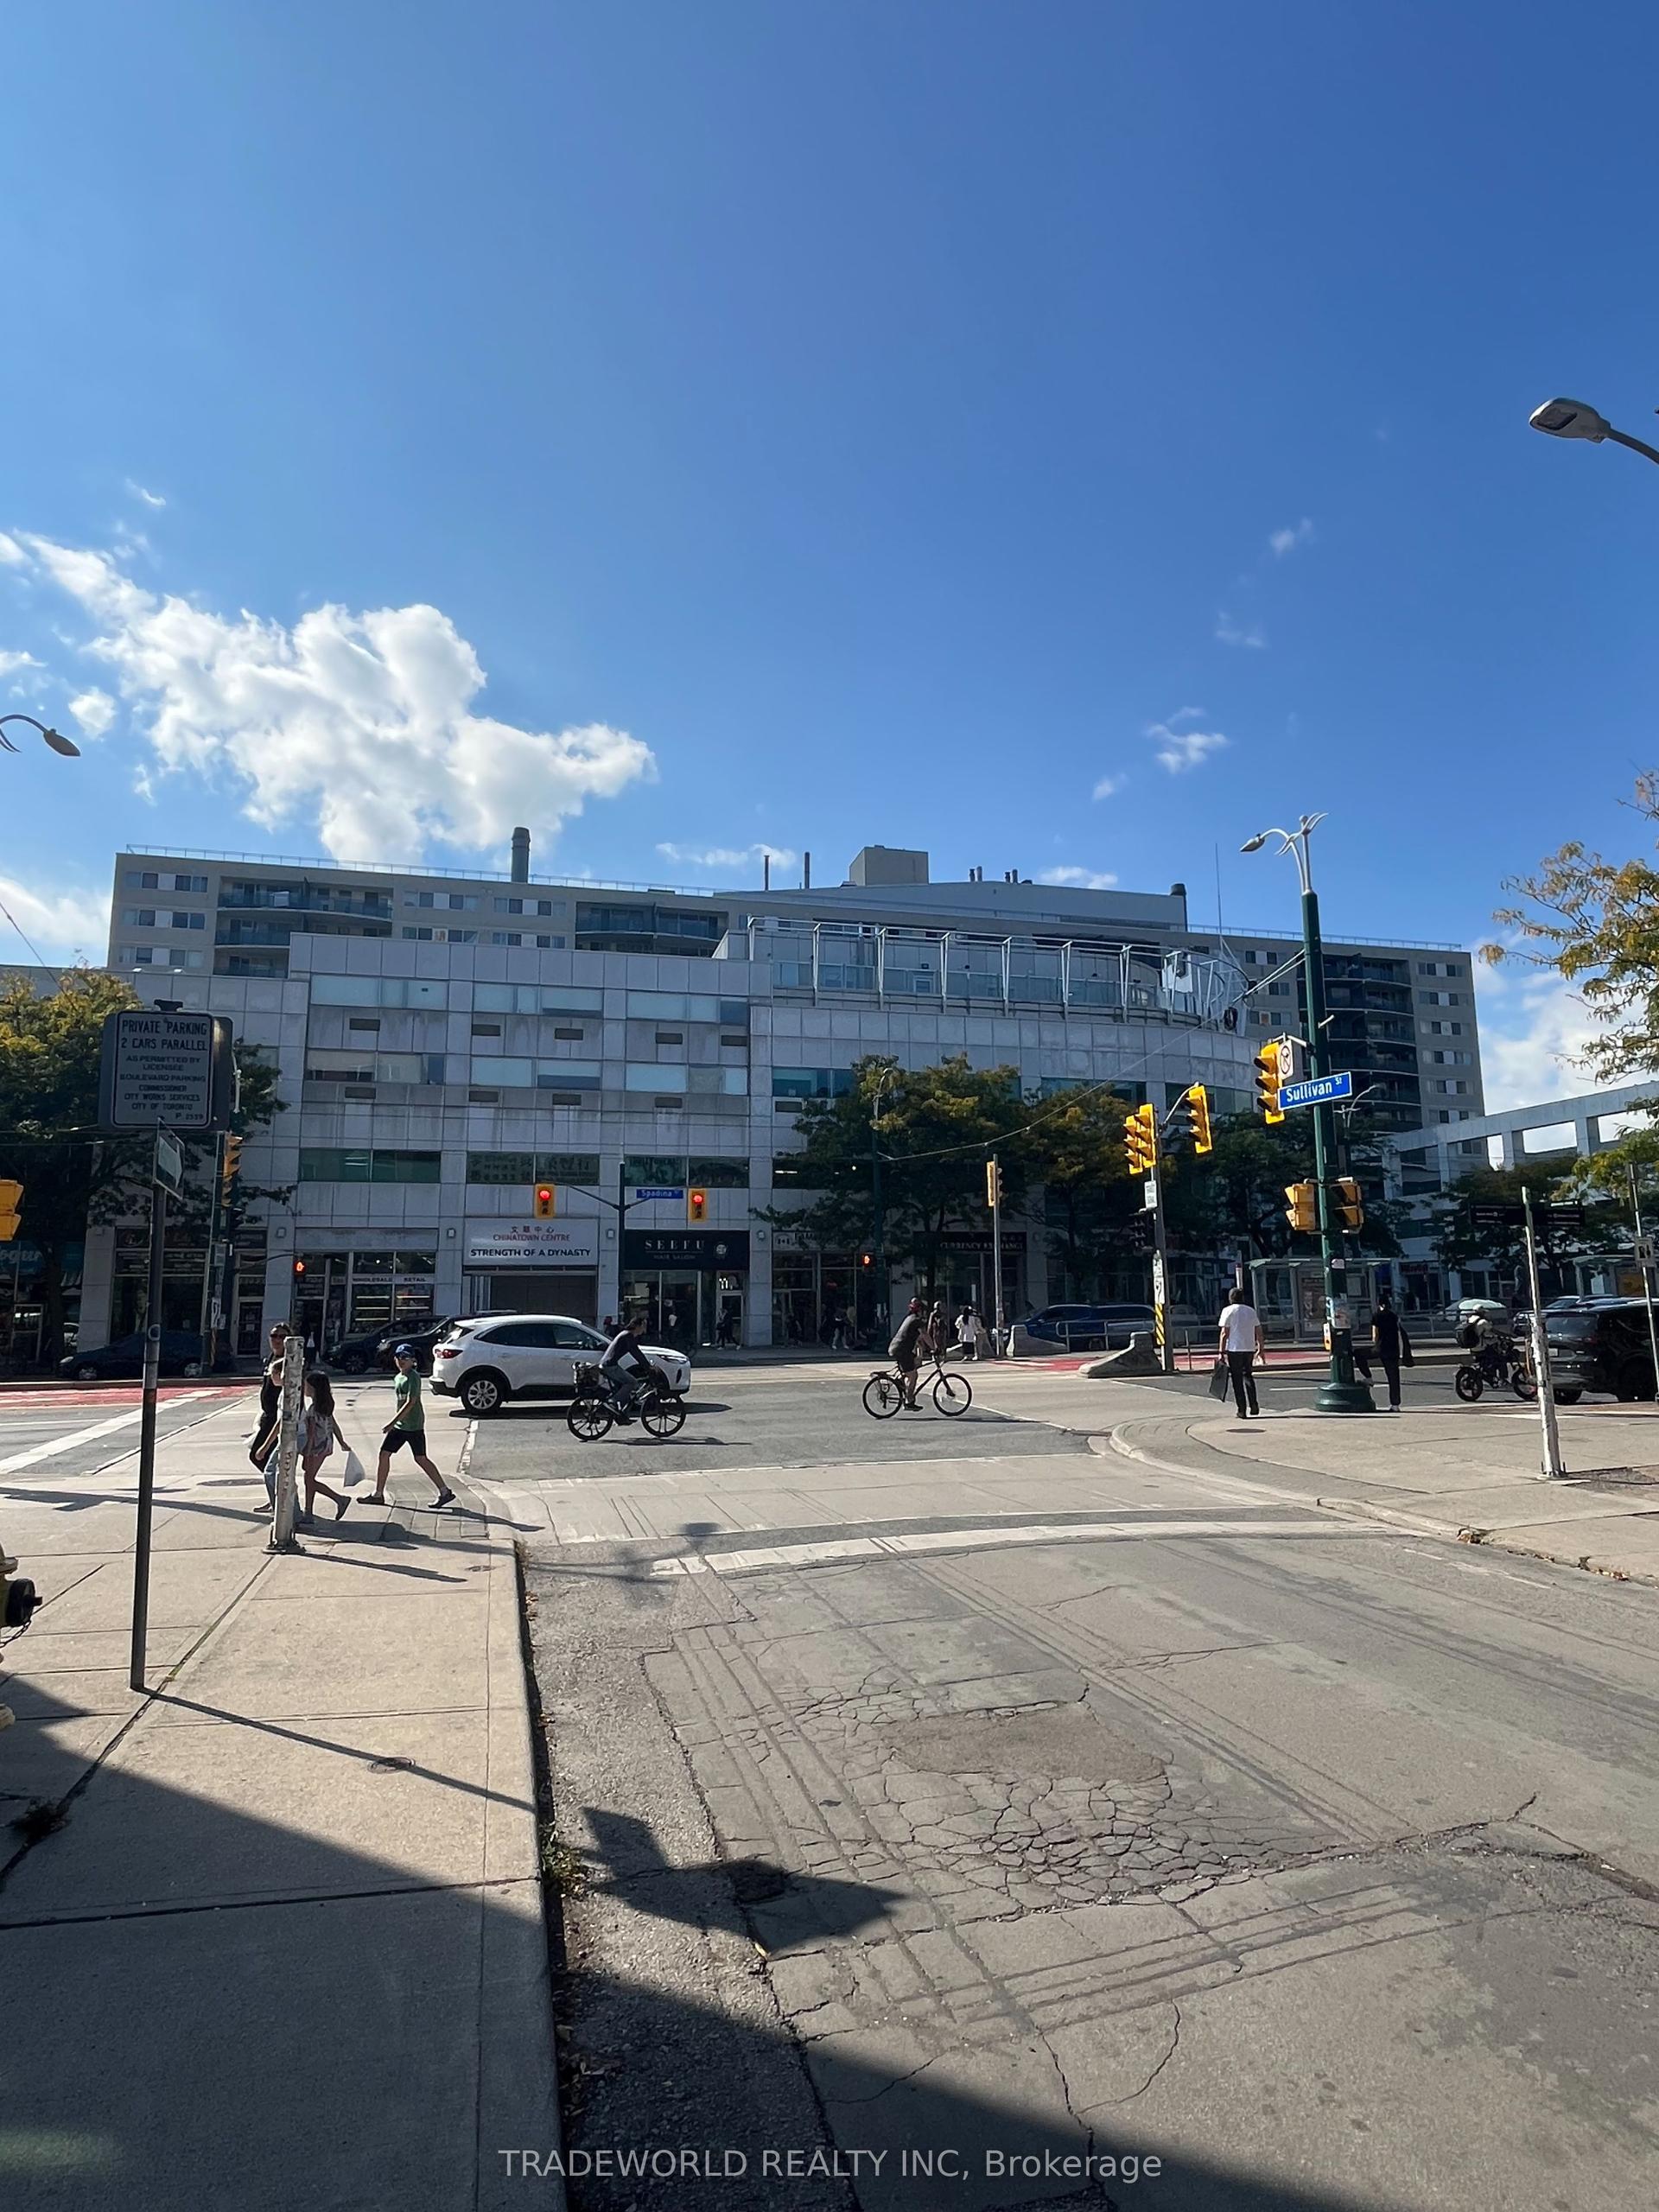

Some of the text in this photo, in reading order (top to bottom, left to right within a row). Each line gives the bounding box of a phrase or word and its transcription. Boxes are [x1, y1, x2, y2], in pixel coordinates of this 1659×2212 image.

[122, 1020, 207, 1035] PRIVATE PARKING
[121, 1038, 207, 1051] 2 CARS PARALLEL
[1286, 1077, 1343, 1103] Sullivan St
[641, 1190, 672, 1198] Spadina
[493, 1233, 539, 1242] CHINATOWN
